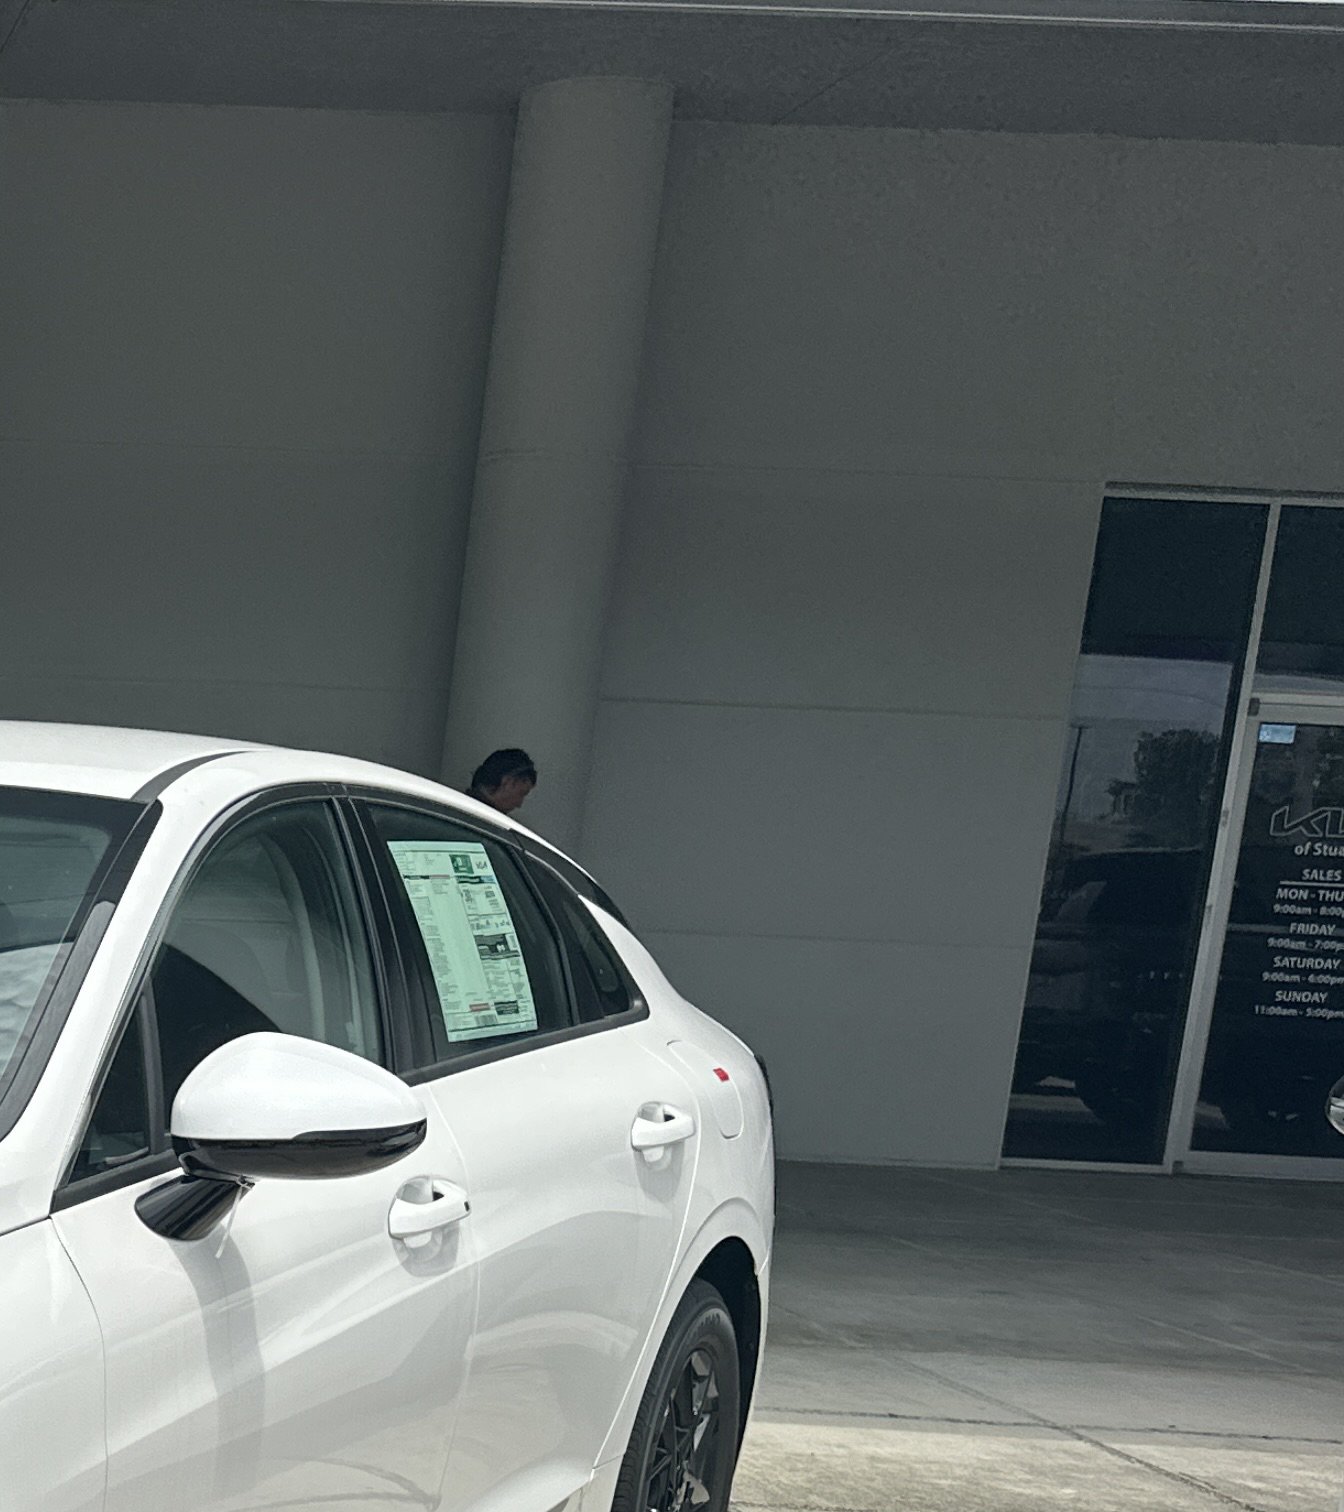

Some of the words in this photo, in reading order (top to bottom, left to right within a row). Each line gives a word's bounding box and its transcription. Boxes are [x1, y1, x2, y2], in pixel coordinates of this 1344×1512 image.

[1269, 804, 1344, 839] KI
[1294, 841, 1312, 857] of
[1312, 842, 1344, 858] Stua
[1301, 868, 1343, 882] SALES
[1275, 887, 1309, 901] MON
[1317, 889, 1344, 903] THU
[1272, 903, 1312, 916] 9:00am
[1288, 922, 1337, 936] FRIDAY
[1266, 936, 1307, 949] 9:00am
[1272, 955, 1342, 970] SATURDAY
[1274, 989, 1329, 1004] SUNDAY
[1254, 1004, 1298, 1017] 11:00am
